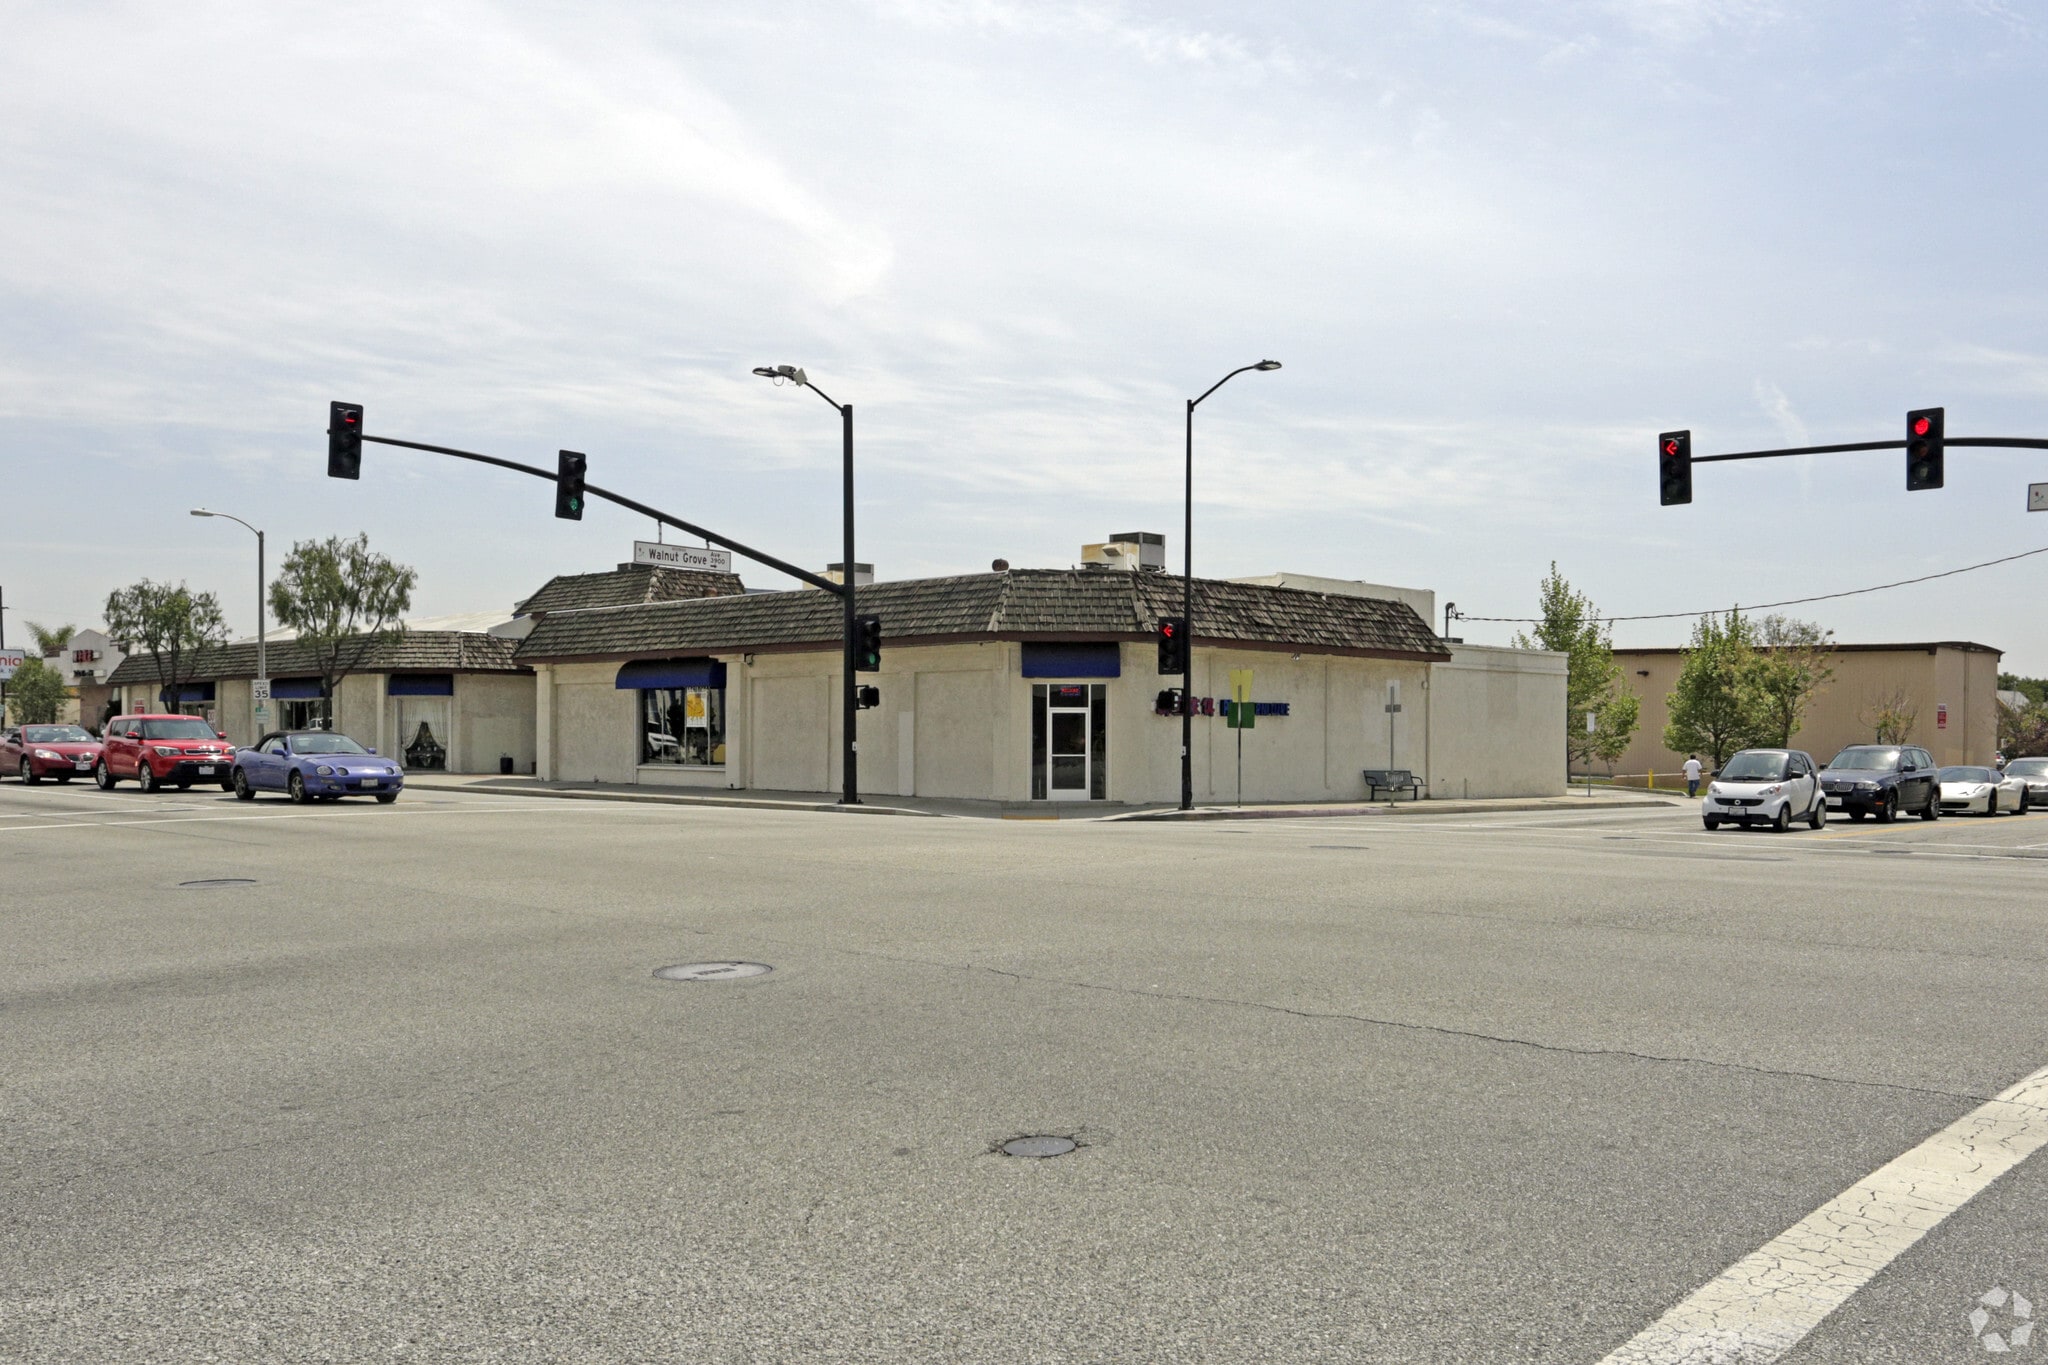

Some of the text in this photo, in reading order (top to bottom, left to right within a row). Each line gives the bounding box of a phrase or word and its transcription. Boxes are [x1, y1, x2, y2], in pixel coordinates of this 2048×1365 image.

[649, 548, 679, 562] Walnut
[682, 552, 708, 565] Grove
[255, 690, 268, 698] 35
[1220, 699, 1290, 716] FRNITURE
